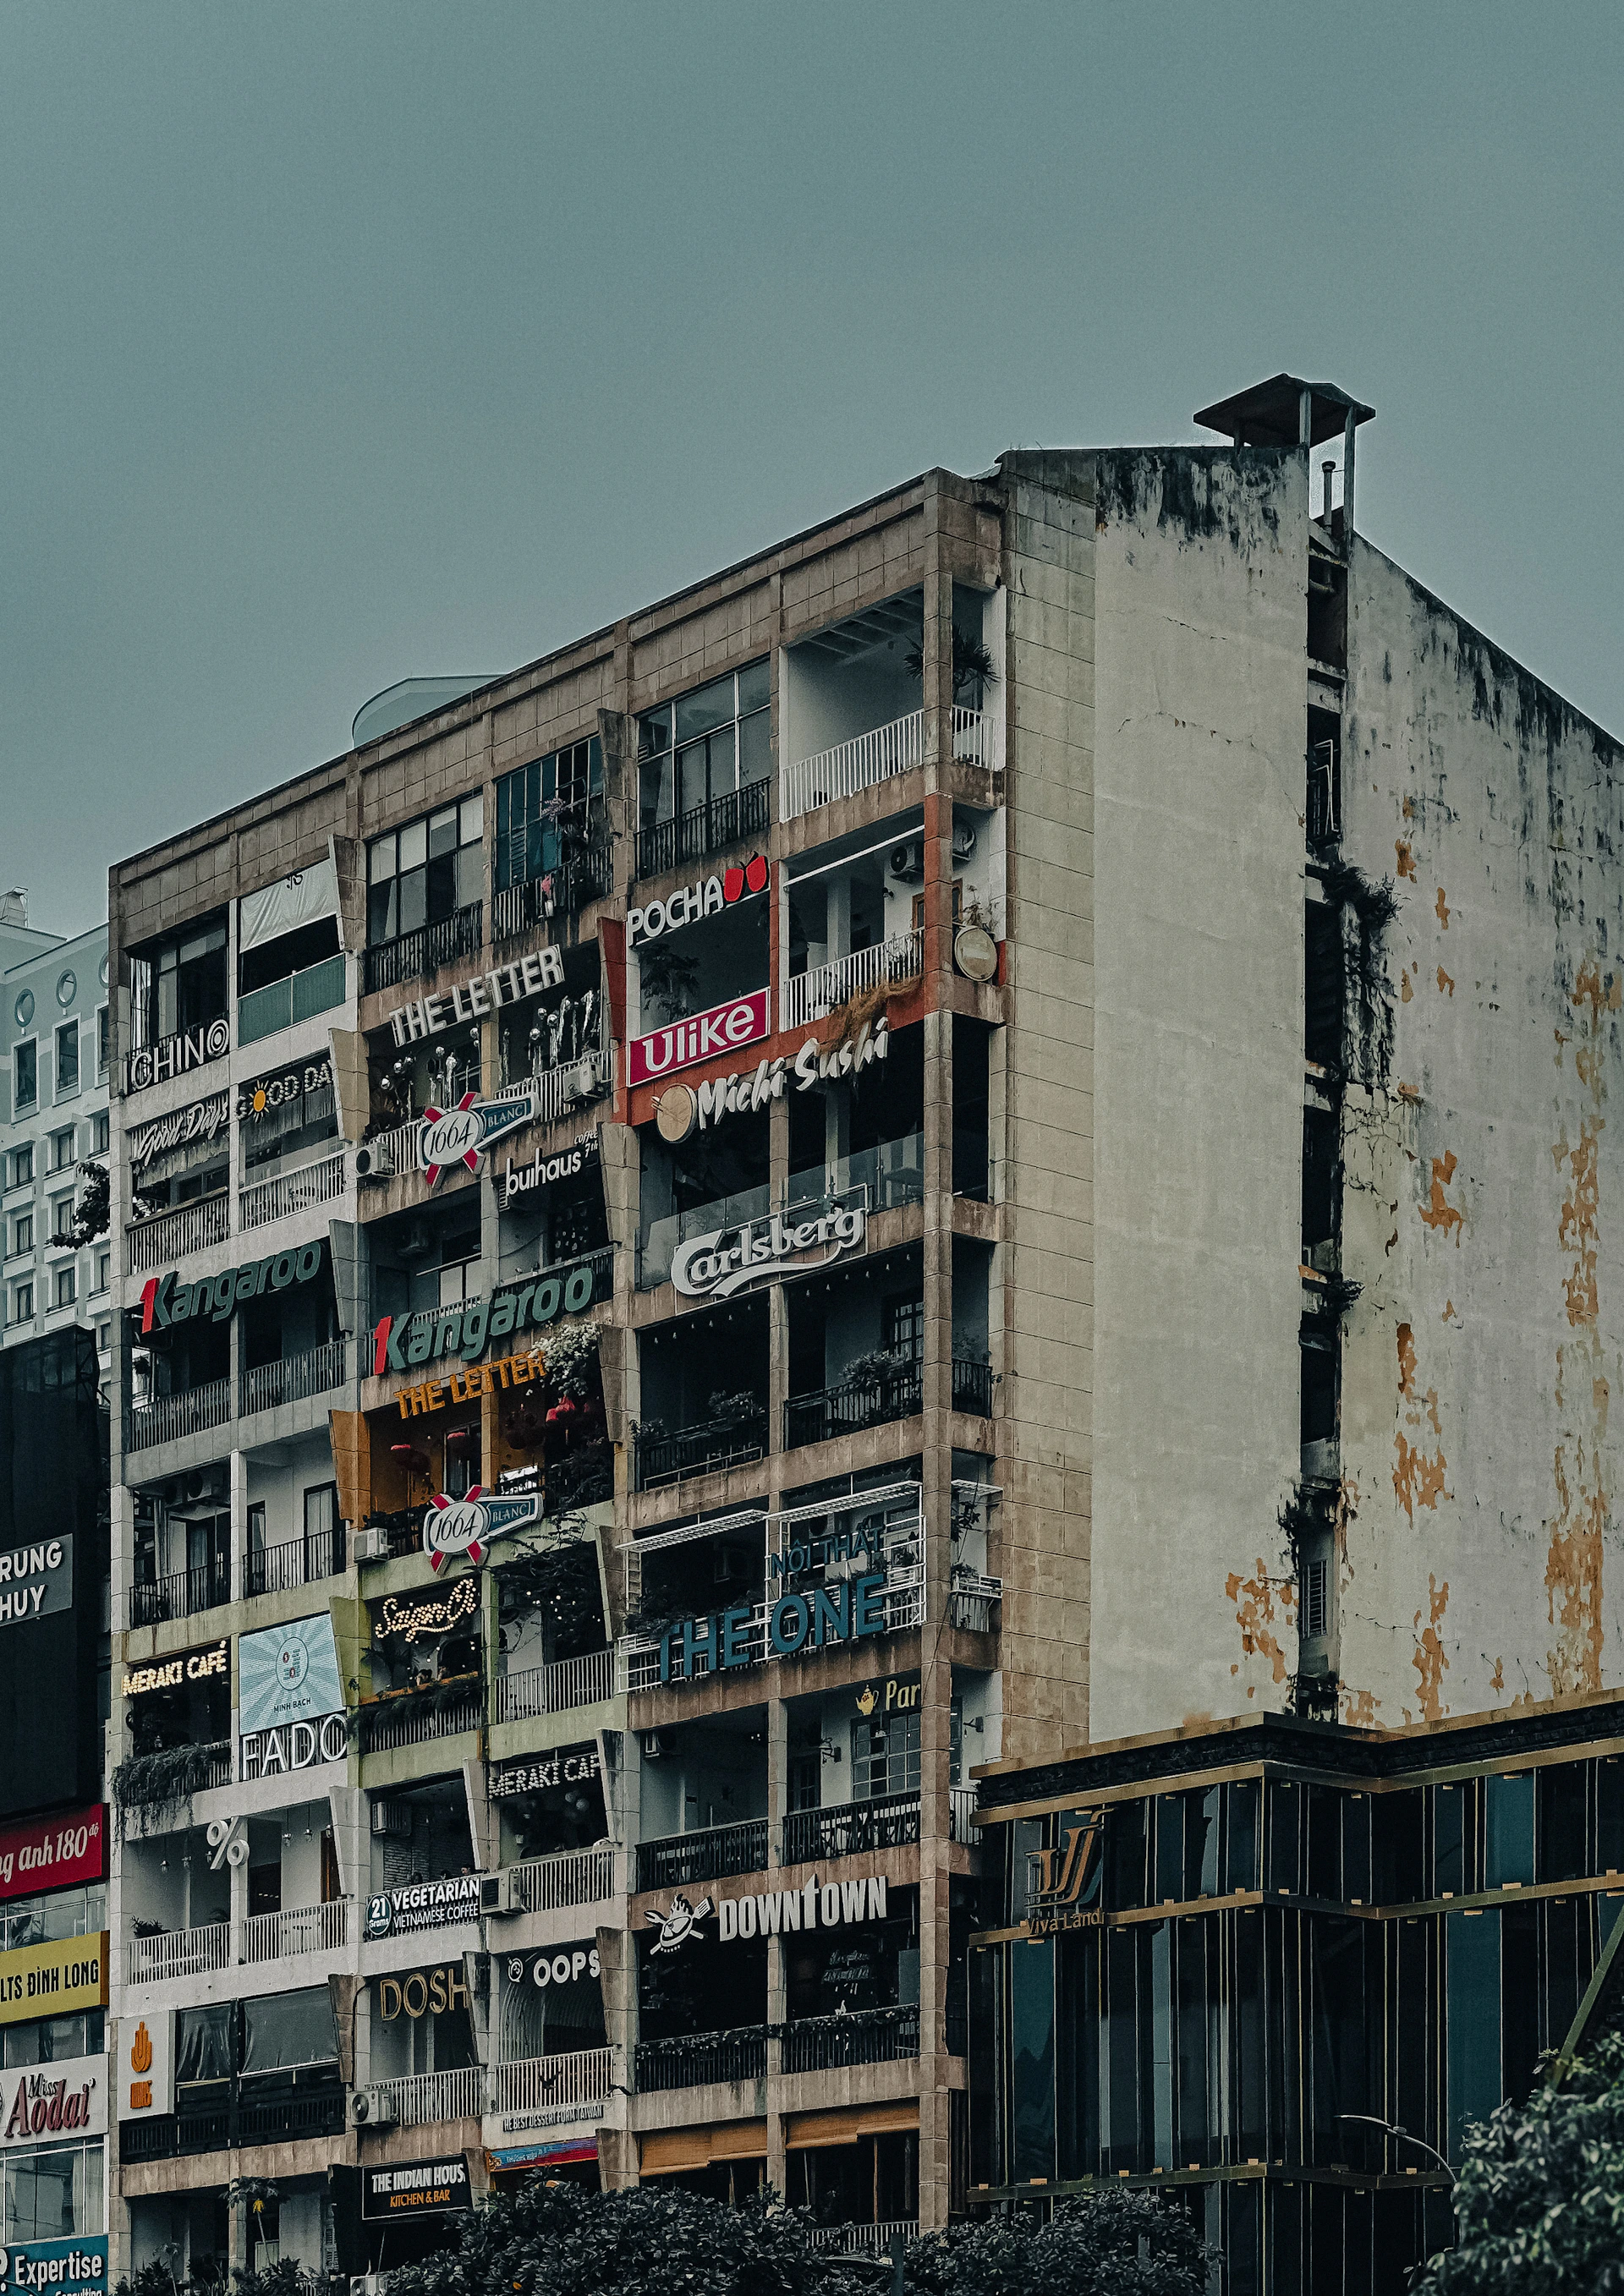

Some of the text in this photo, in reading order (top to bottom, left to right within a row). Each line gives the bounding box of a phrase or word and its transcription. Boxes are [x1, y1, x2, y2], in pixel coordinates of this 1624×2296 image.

[626, 875, 724, 947] POCHA
[389, 944, 566, 1048] THE LETTER
[642, 1005, 755, 1072] Ulike
[304, 1059, 333, 1092] DA
[698, 1016, 888, 1130] Michi Sushi
[138, 1115, 184, 1167] Good
[429, 1104, 524, 1157] 1664 BLANC
[671, 1207, 866, 1297] Carlsberg
[394, 1351, 546, 1420] THE LETTER
[435, 1504, 527, 1543] 1664 BLANC
[0, 1542, 63, 1583] RUNG
[0, 1584, 46, 1621] HUY
[661, 1574, 885, 1681] THE ONE
[122, 1640, 228, 1696] MERAKI CAFÉ
[273, 1702, 291, 1713] MINH
[488, 1762, 560, 1800] MERAKI
[19, 1834, 53, 1871] anh
[56, 1826, 88, 1862] 180
[372, 1898, 386, 1918] 21
[392, 1878, 480, 1911] VEGETARIAN
[369, 1918, 389, 1928] Grams
[393, 1903, 478, 1929] VIETNAMESE COFFEE
[1026, 1917, 1058, 1937] Viva
[27, 1966, 59, 1997] ĐÌNH
[64, 1959, 99, 1990] LONG
[534, 1949, 601, 1987] OOPS
[28, 2073, 59, 2099] Miss
[4, 2076, 91, 2138] Aodai
[513, 2116, 529, 2129] BEST
[529, 2112, 557, 2128] DESSERT
[372, 2163, 466, 2193] THE INDIAN HOUS
[390, 2189, 451, 2208] KITCHEN & BAR
[14, 2250, 102, 2292] Expertise
